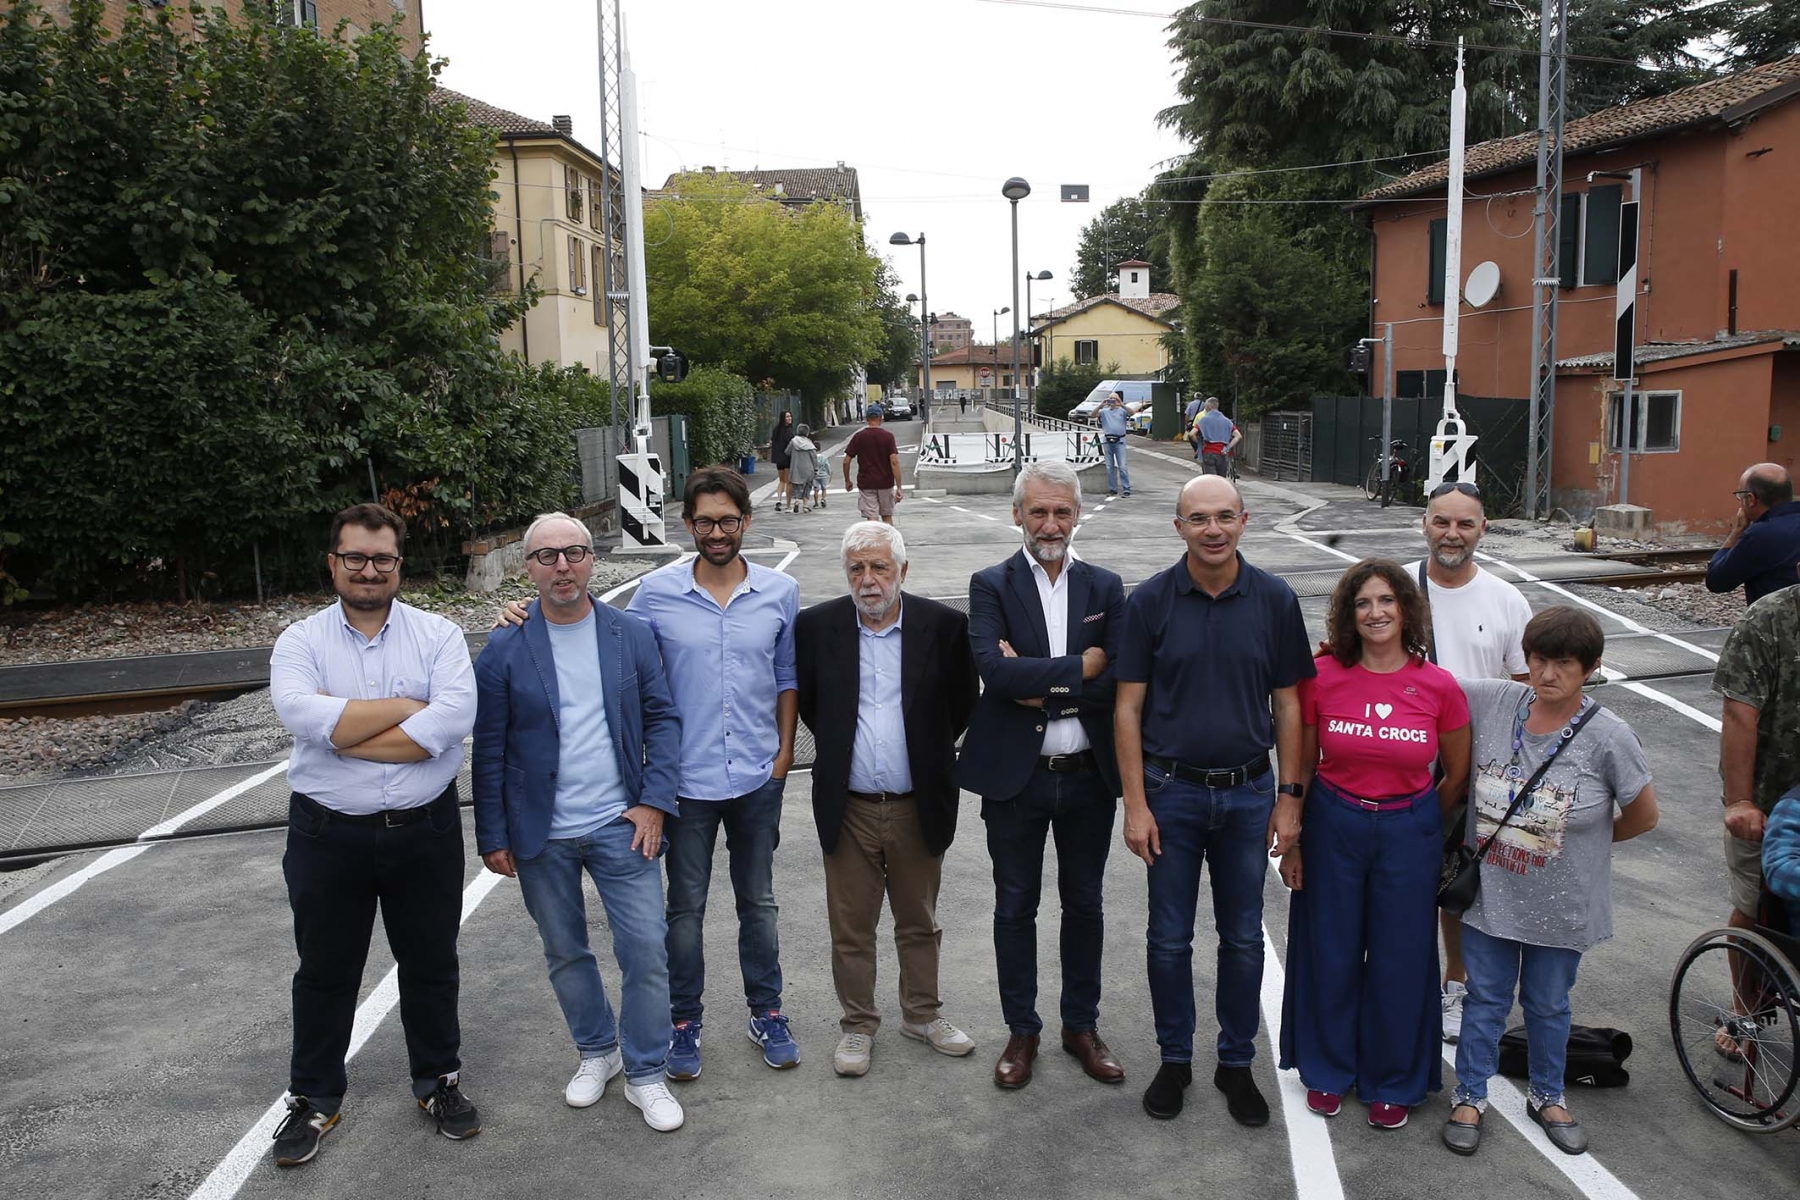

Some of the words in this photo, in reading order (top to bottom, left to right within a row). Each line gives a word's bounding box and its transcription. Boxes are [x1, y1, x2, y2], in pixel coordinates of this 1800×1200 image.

[1365, 703, 1371, 718] I
[1328, 719, 1374, 738] SANTA
[1378, 726, 1428, 743] CROCE
[1486, 852, 1528, 875] BEAUTIFUL
[1531, 854, 1547, 868] ARE
